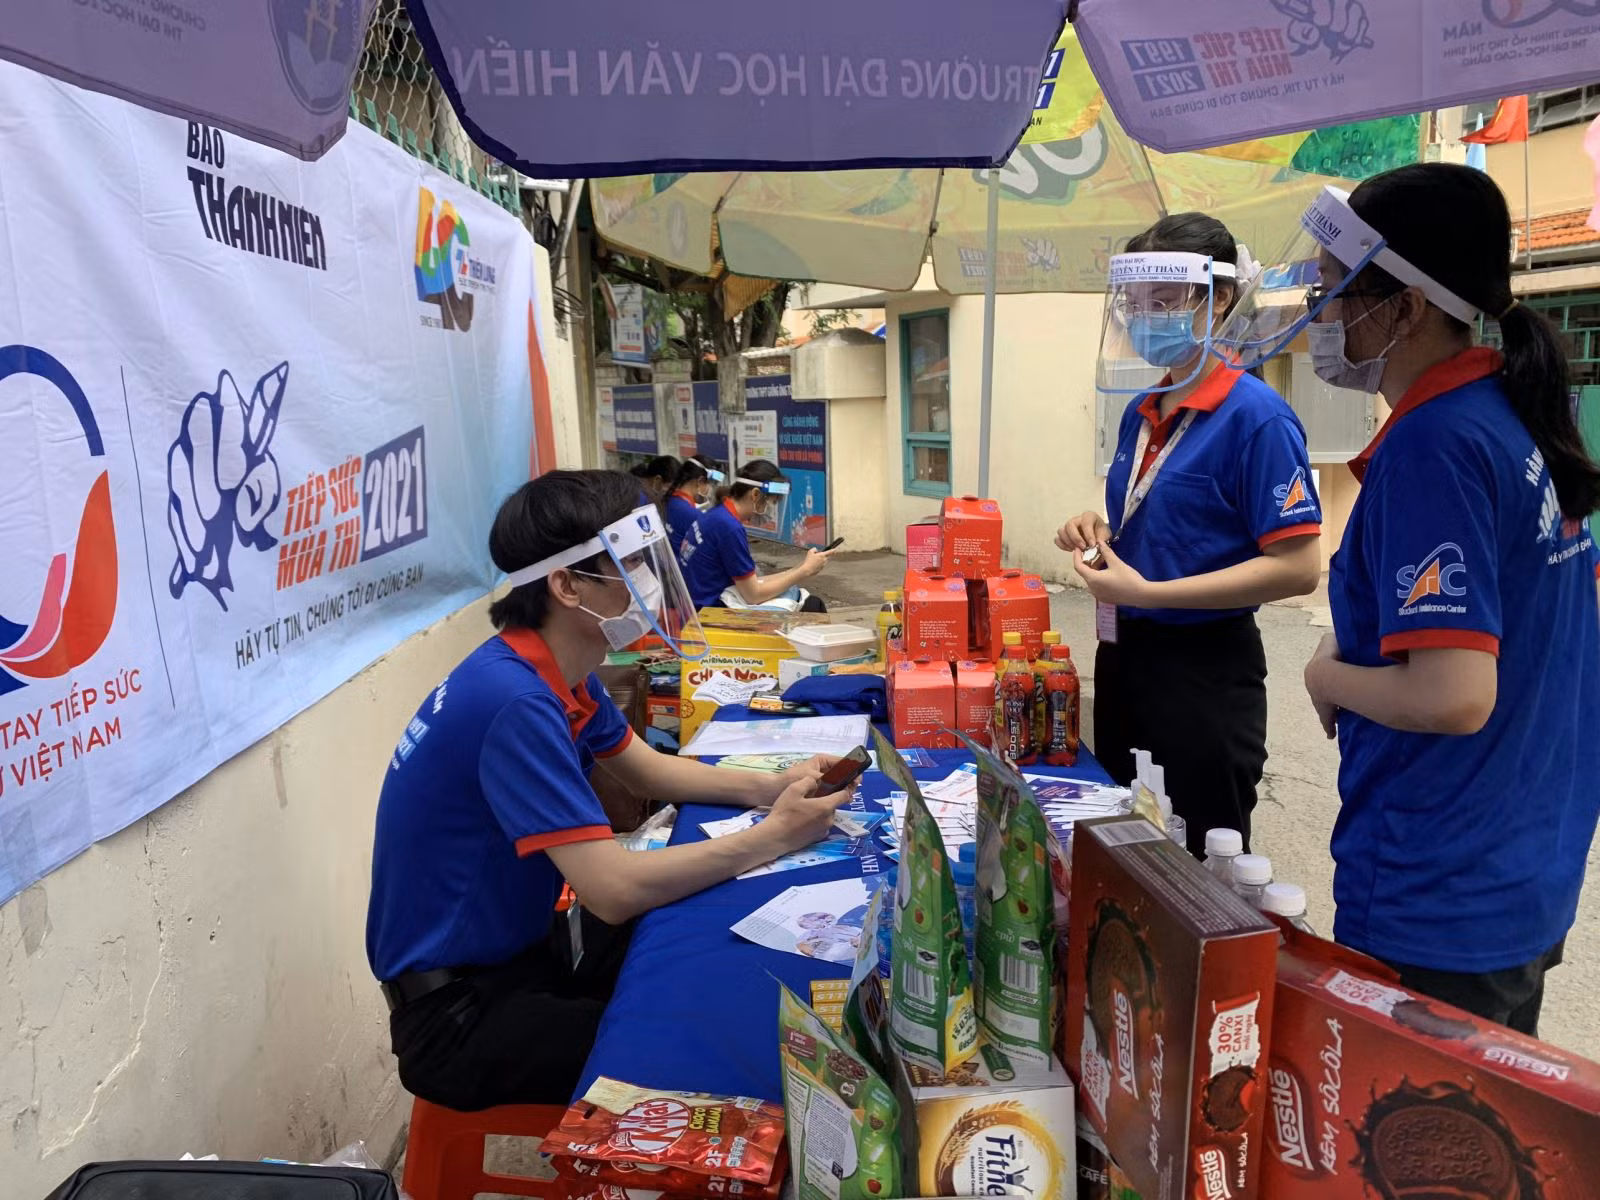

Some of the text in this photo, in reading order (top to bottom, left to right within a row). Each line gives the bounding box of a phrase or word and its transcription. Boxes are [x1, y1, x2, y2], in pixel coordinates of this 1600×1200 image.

[1155, 263, 1188, 274] THÀNH
[283, 436, 425, 553] TIẾP SỨC 2021
[276, 515, 361, 592] MÙA THI
[235, 562, 424, 670] HÃY TỰ TIN, CHÚNG TÔI ĐI CÙNG BẠN
[1447, 603, 1467, 614] Center
[0, 667, 142, 750] TAY TIẾP SỨC
[10, 742, 64, 788] VIỆT
[72, 716, 122, 760] NAM
[1232, 1014, 1244, 1053] CANXI
[689, 1107, 723, 1134] CHOCO BANANA
[1318, 1016, 1344, 1175] KEM SÔCÔLA
[977, 1147, 985, 1185] nutritious
[985, 1134, 1017, 1196] Fitne
